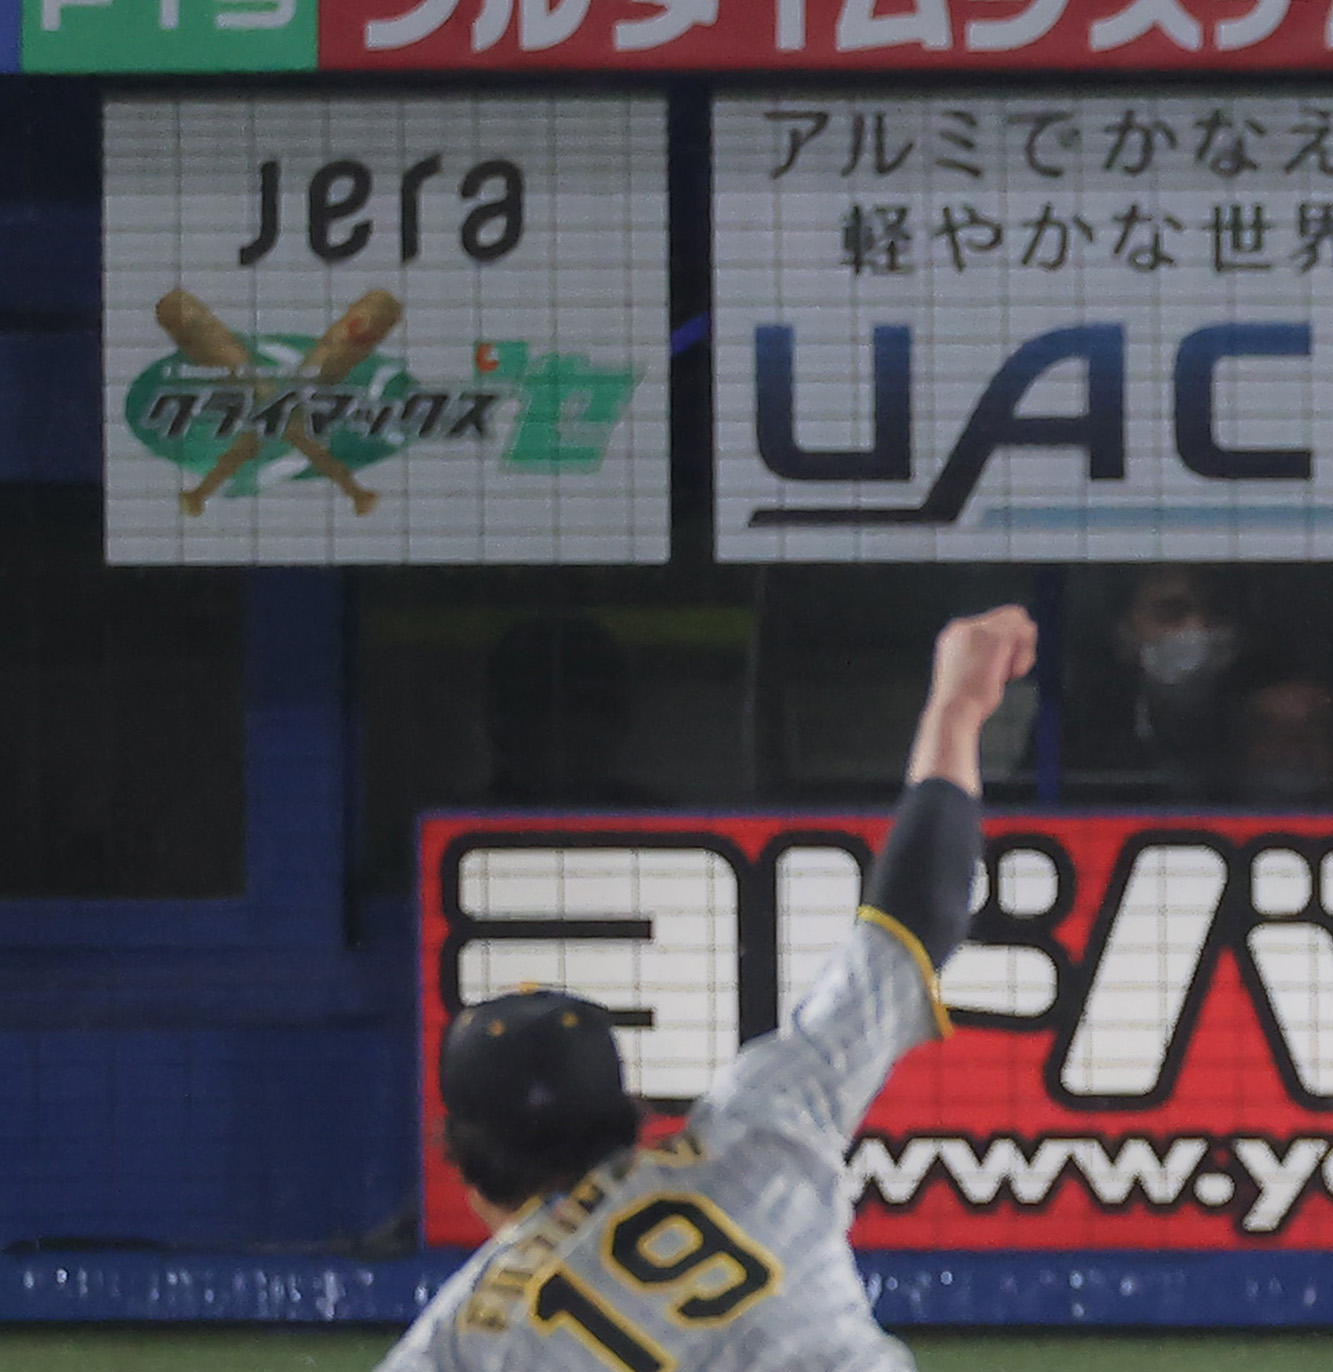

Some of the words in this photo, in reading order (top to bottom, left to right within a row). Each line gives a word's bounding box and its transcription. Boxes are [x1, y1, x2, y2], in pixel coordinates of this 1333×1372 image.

[148, 388, 500, 440] クライマックス
